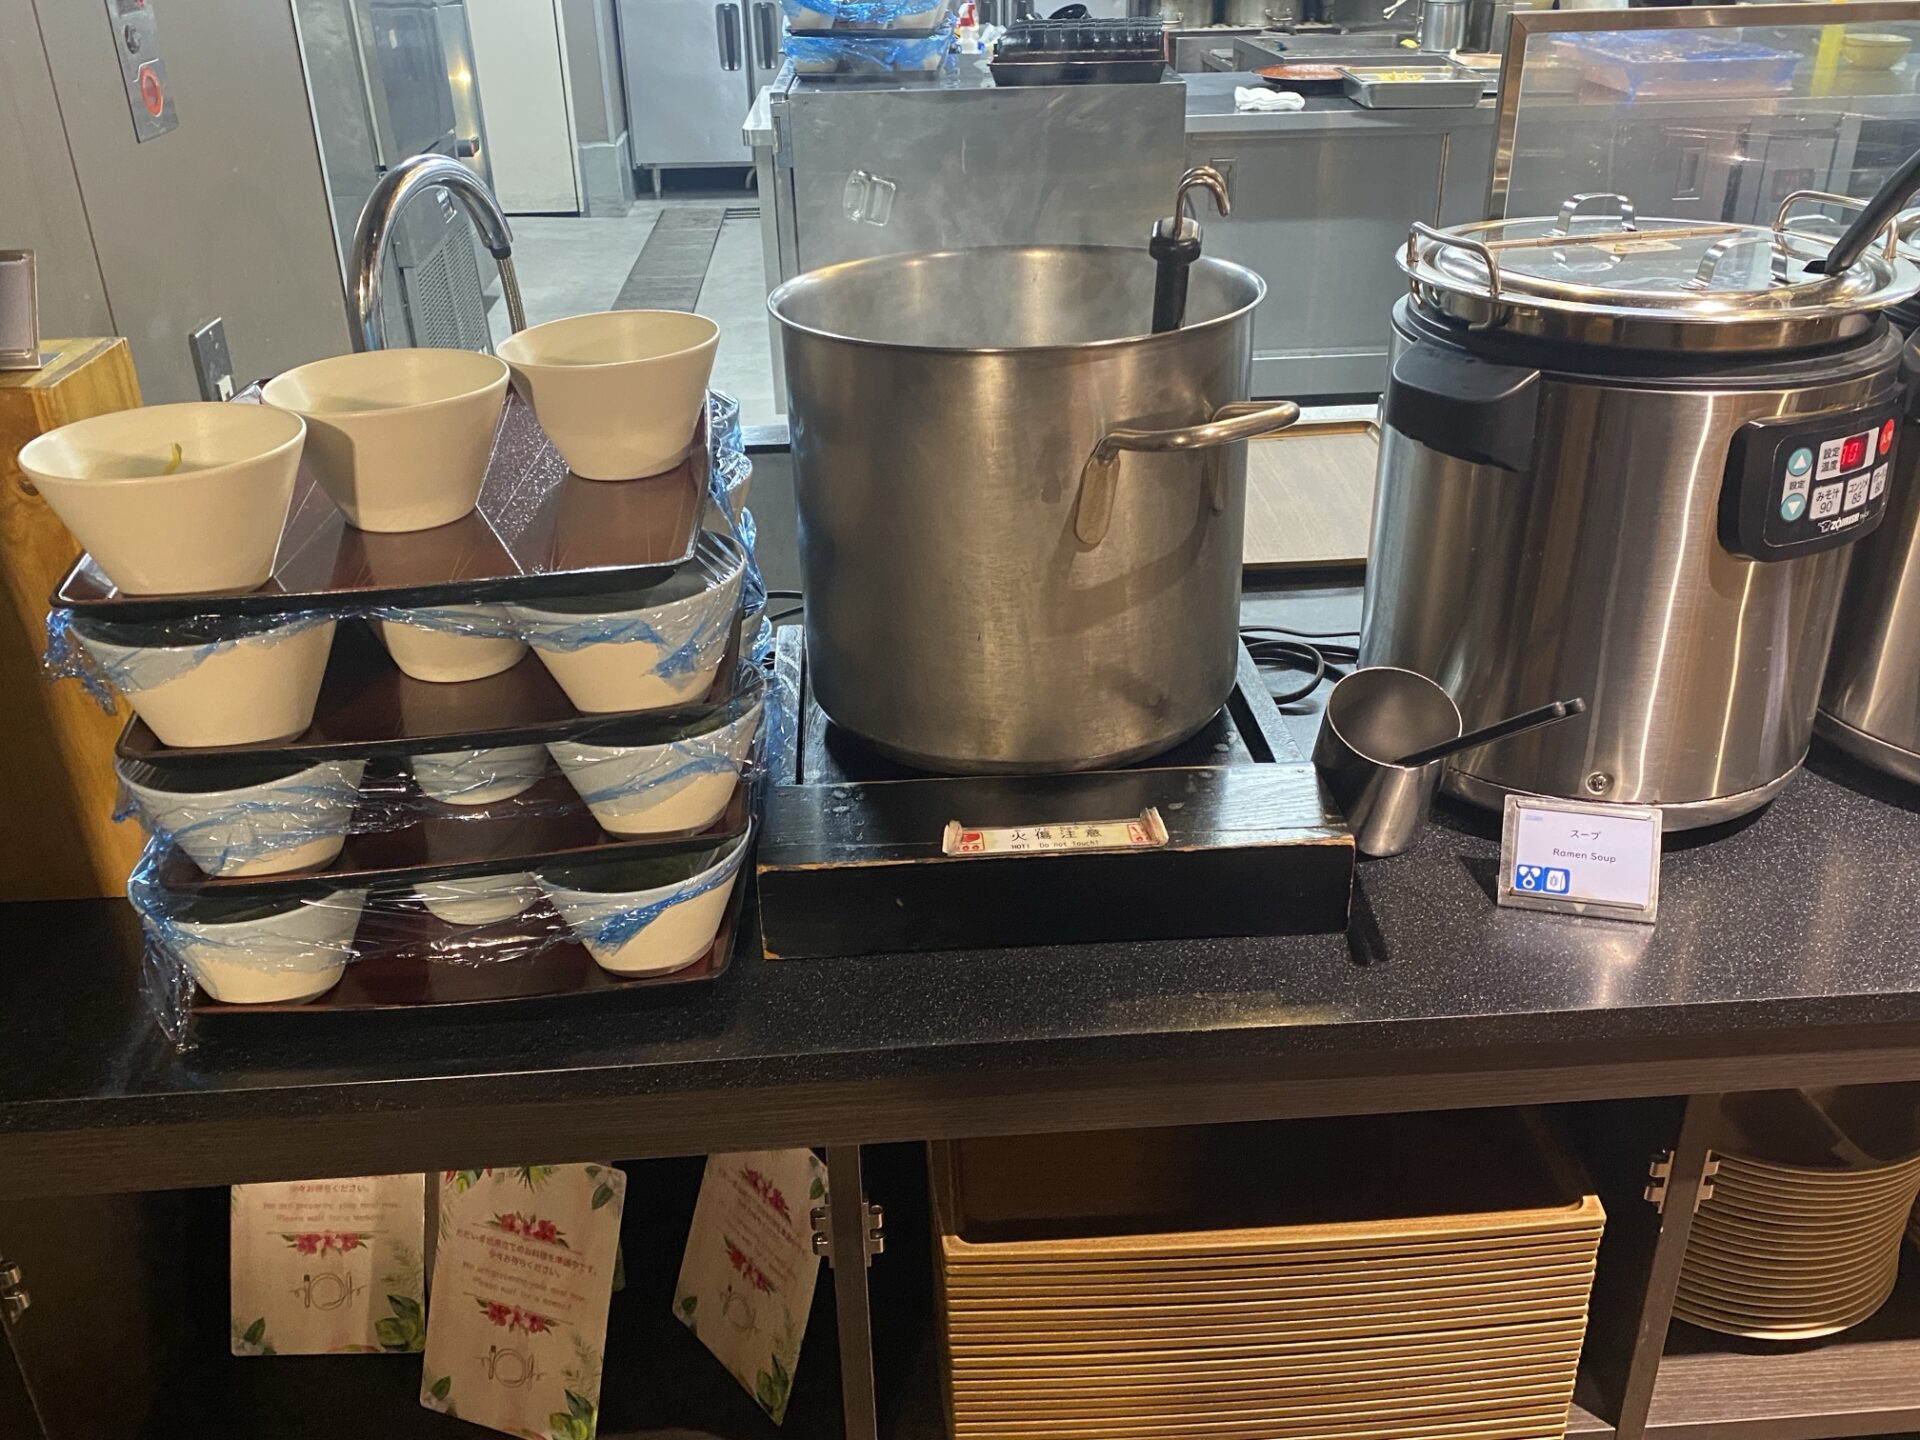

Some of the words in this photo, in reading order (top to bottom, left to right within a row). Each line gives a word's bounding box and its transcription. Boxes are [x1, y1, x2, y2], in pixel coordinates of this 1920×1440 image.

[1816, 488, 1840, 502] みそ汁
[1820, 501, 1833, 514] 90
[1553, 848, 1587, 860] Ramen
[1591, 852, 1616, 864] Soup
